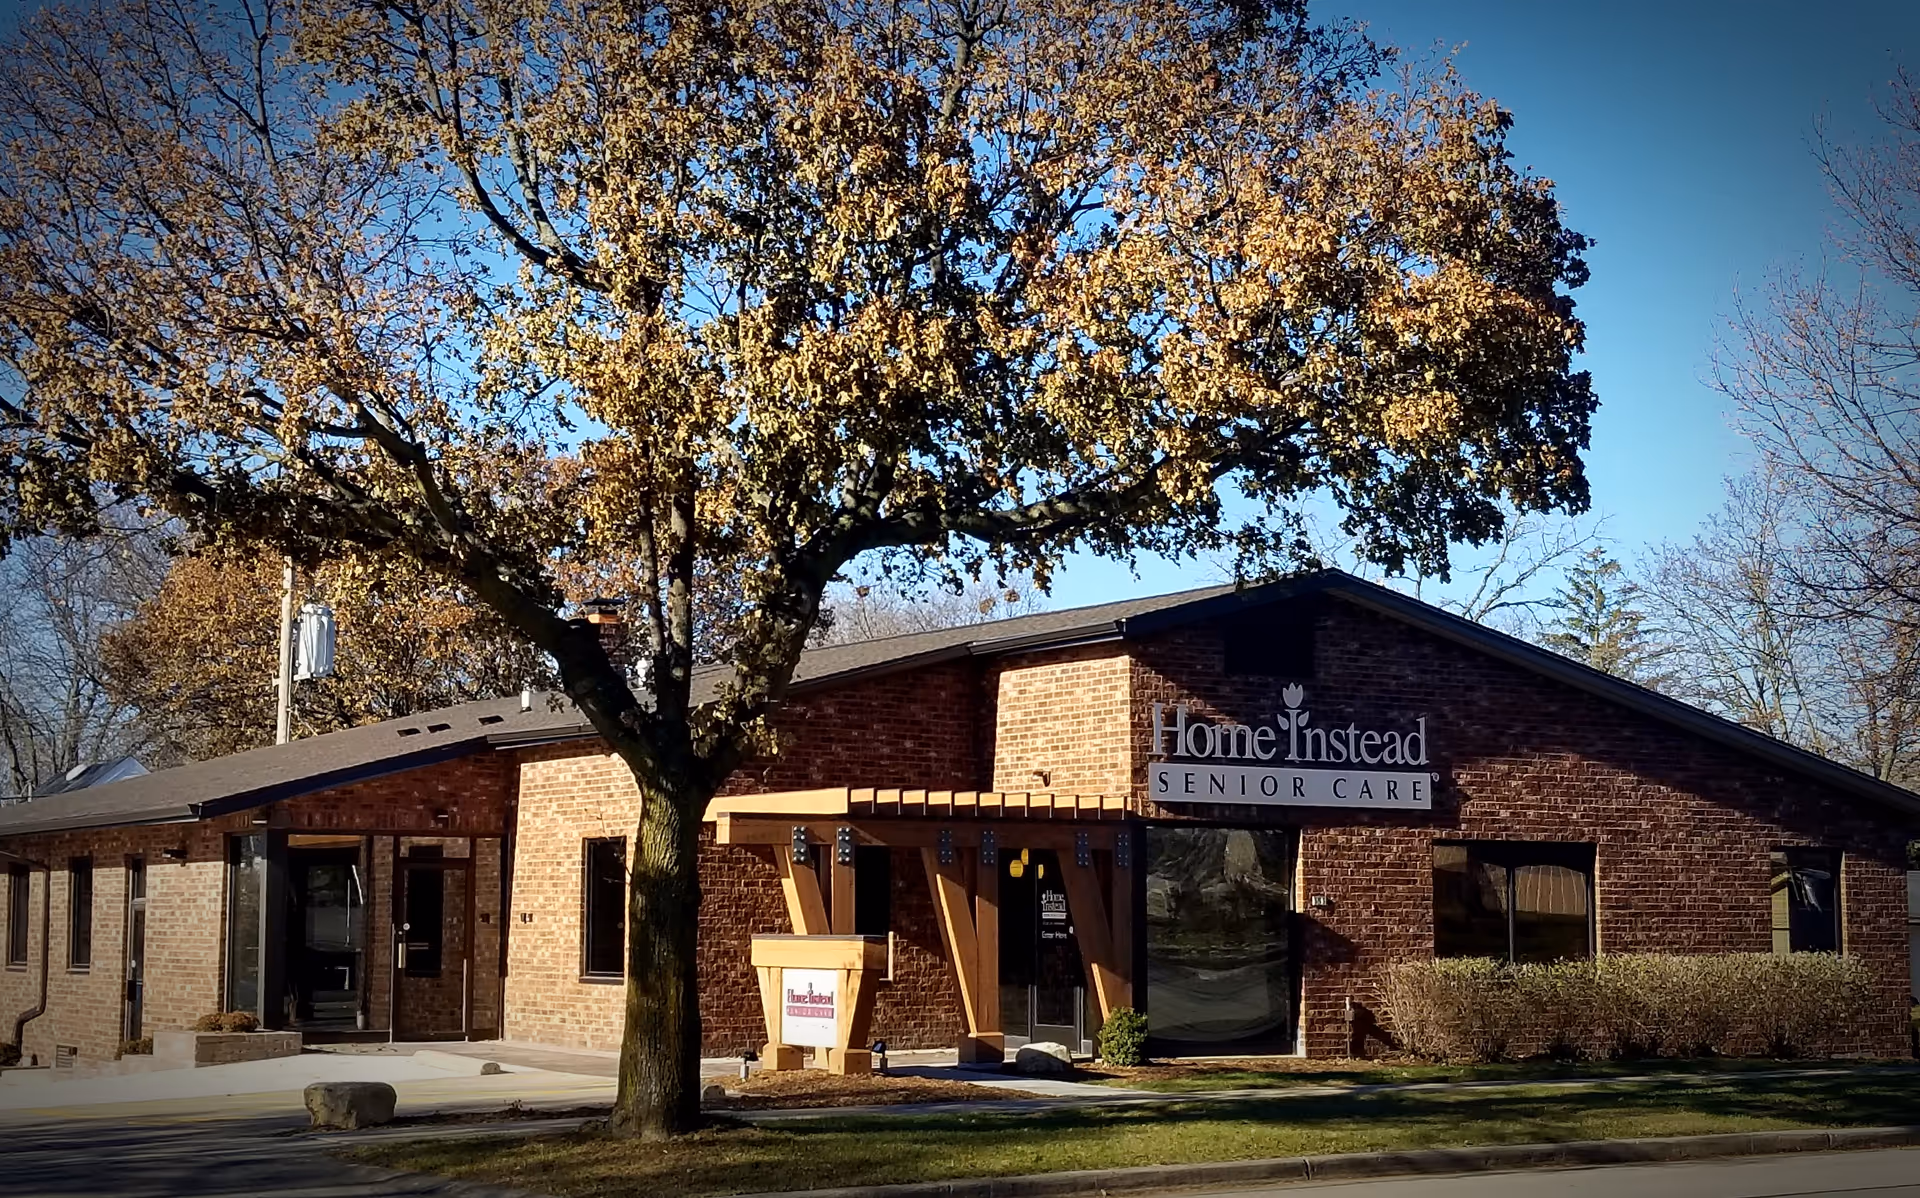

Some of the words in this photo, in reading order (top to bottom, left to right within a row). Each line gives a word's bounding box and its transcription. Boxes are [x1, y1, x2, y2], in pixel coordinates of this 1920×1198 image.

[1147, 702, 1277, 760] Home
[1283, 708, 1430, 766] Instead
[1157, 770, 1306, 798] SENIOR
[1332, 777, 1423, 801] CARE
